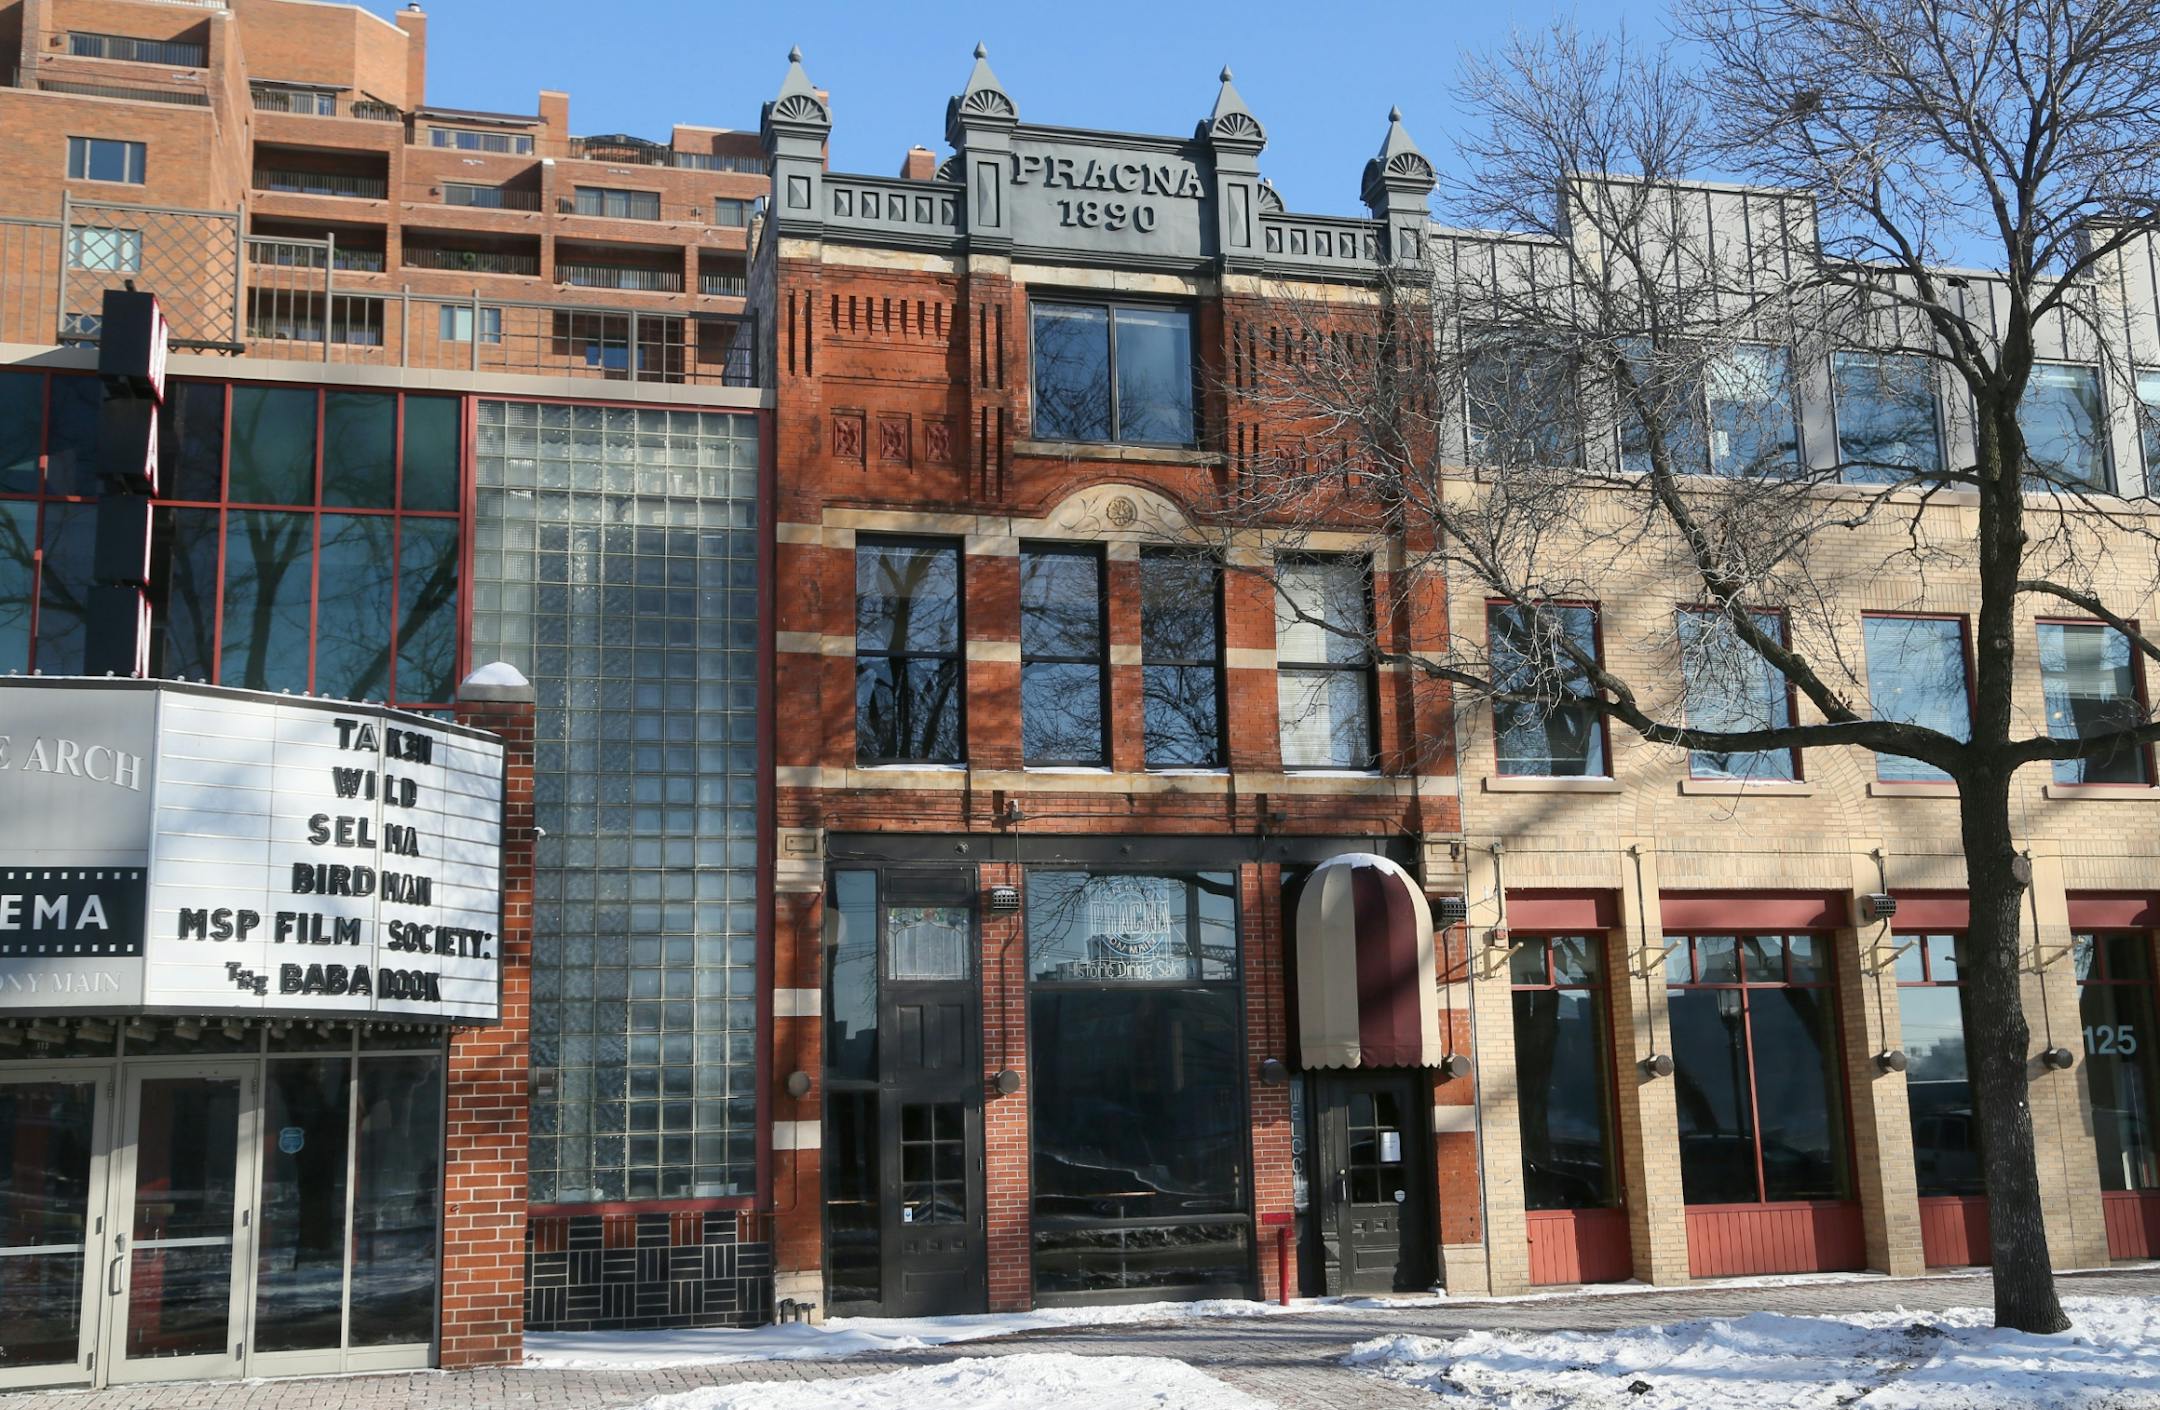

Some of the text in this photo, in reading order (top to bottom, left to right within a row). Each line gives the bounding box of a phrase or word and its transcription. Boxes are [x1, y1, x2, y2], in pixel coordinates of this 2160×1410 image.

[1057, 199, 1158, 233] 1890
[20, 736, 144, 792] ARCH
[332, 766, 418, 808] WILD
[307, 813, 420, 857] SELMA
[292, 862, 432, 906] BIRDMAN
[0, 894, 109, 930] EMA
[177, 908, 260, 942] MSP
[274, 911, 361, 946] FILM
[0, 972, 121, 993] NY MAIN
[225, 961, 269, 996] THE
[2083, 1024, 2137, 1055] 125
